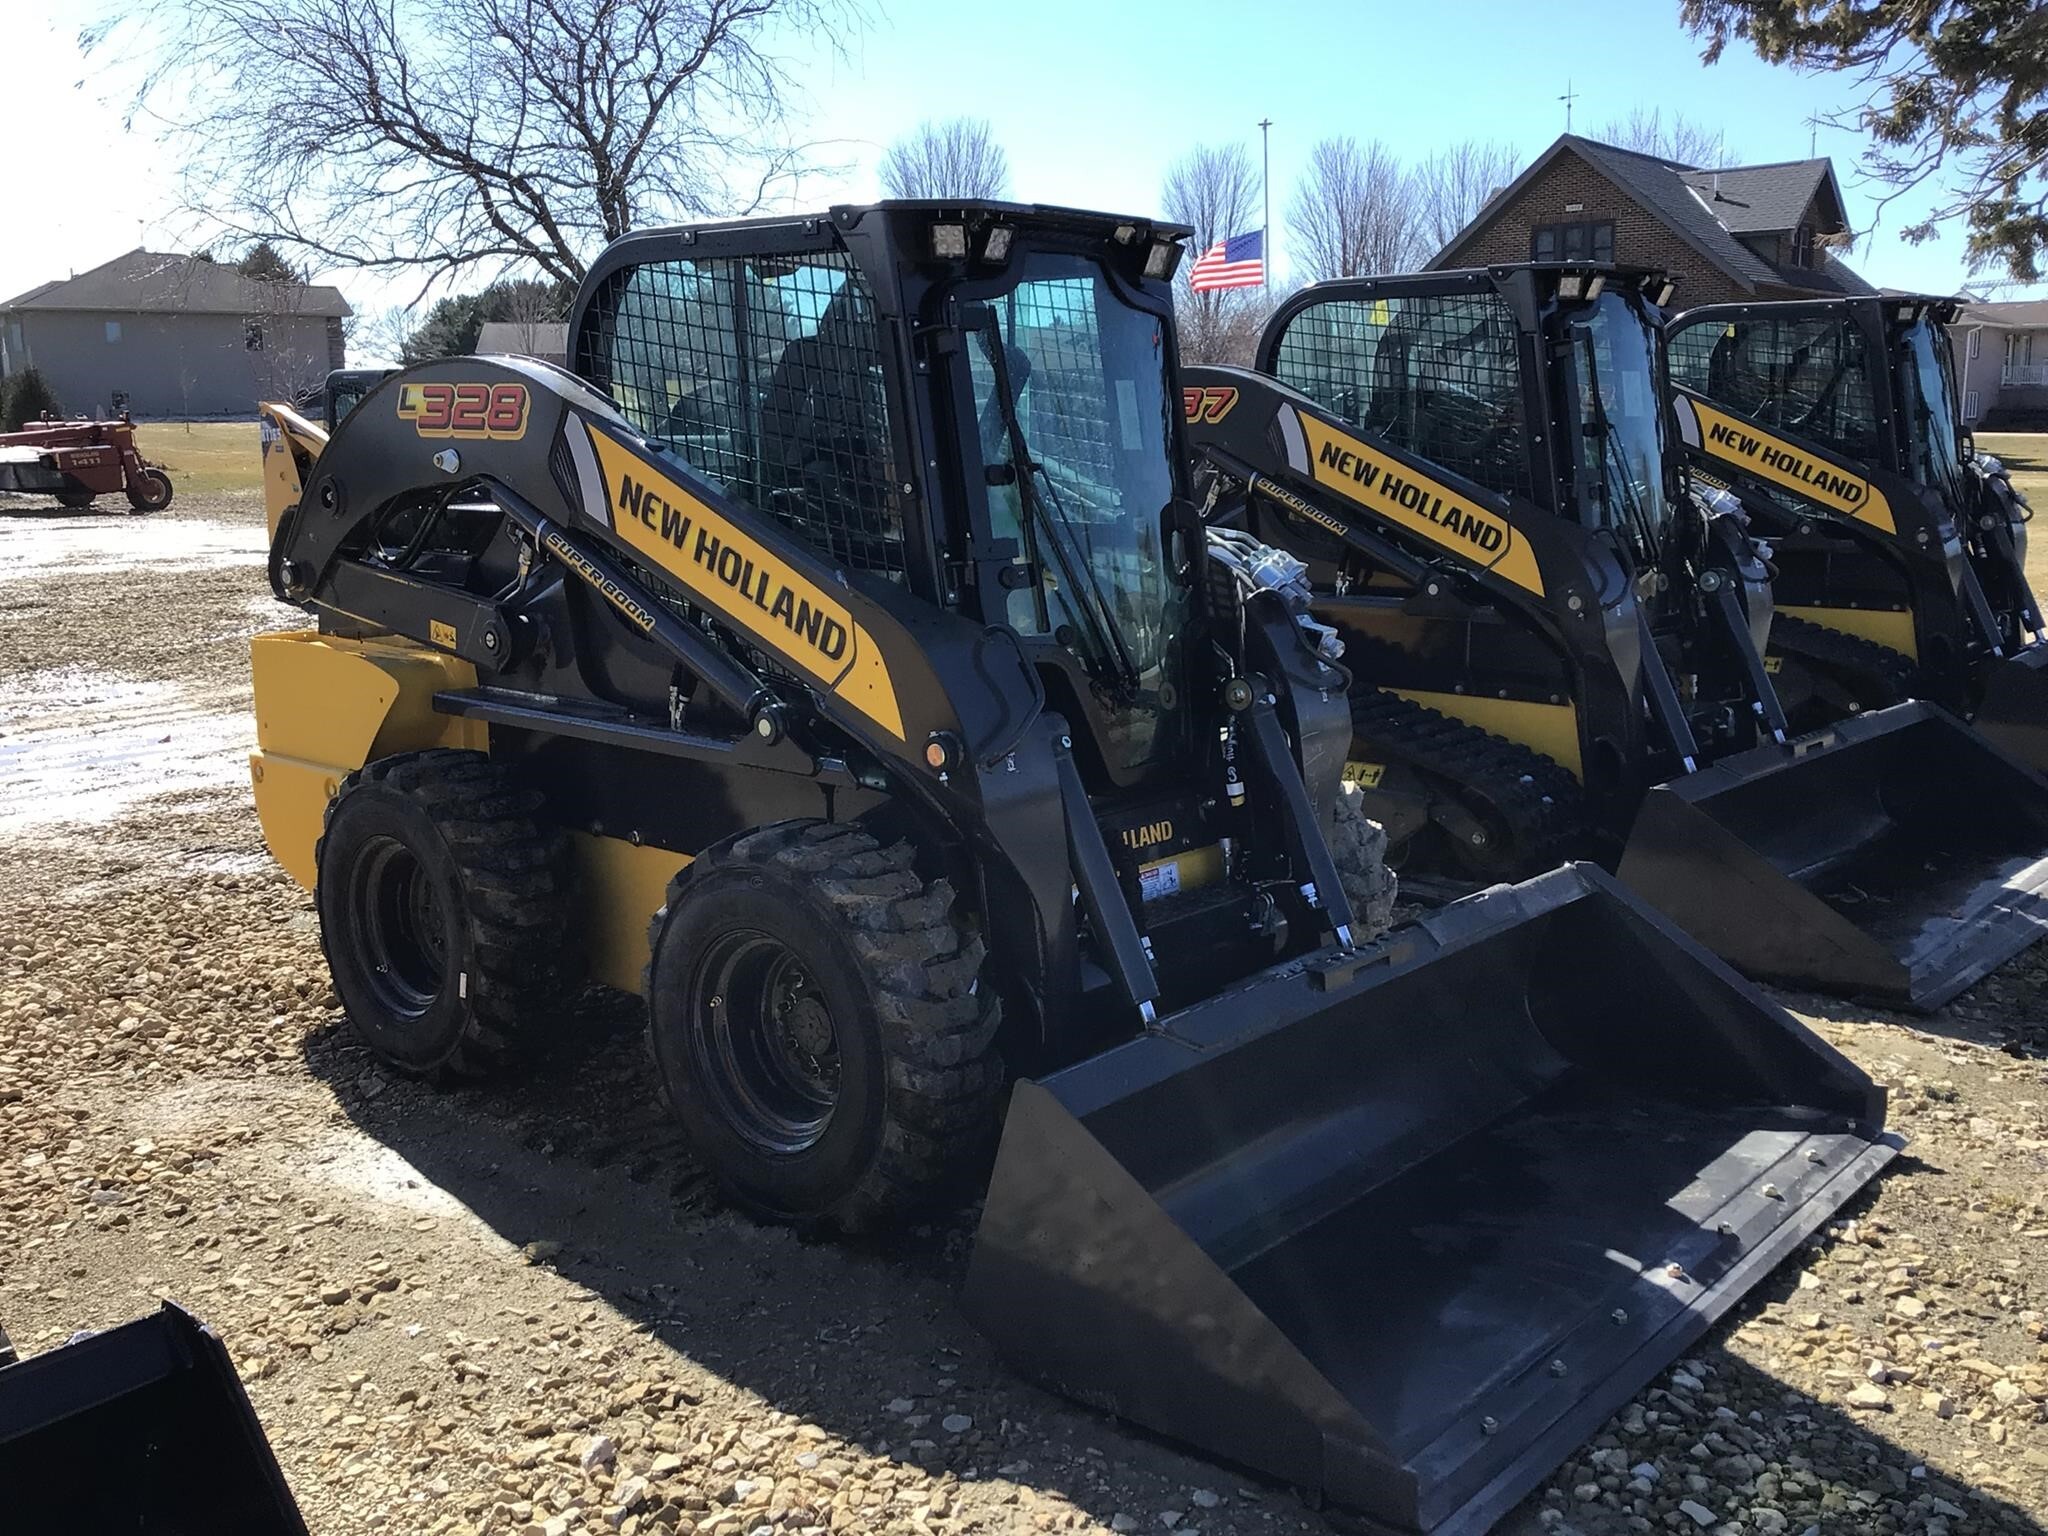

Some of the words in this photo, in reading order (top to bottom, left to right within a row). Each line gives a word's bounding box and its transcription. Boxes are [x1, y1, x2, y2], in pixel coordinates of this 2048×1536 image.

[397, 384, 531, 440] L328
[1257, 478, 1306, 511] SUPER
[1302, 505, 1349, 536] BOOM
[1319, 441, 1380, 488] NEW
[1380, 473, 1503, 552] HOLLAND
[1709, 423, 1761, 457] NEW
[1760, 446, 1862, 503] HOLLAND
[547, 532, 604, 588] SUPER
[601, 580, 656, 632] BOOM
[618, 473, 692, 550] NEW
[693, 527, 847, 661] HOLLAND
